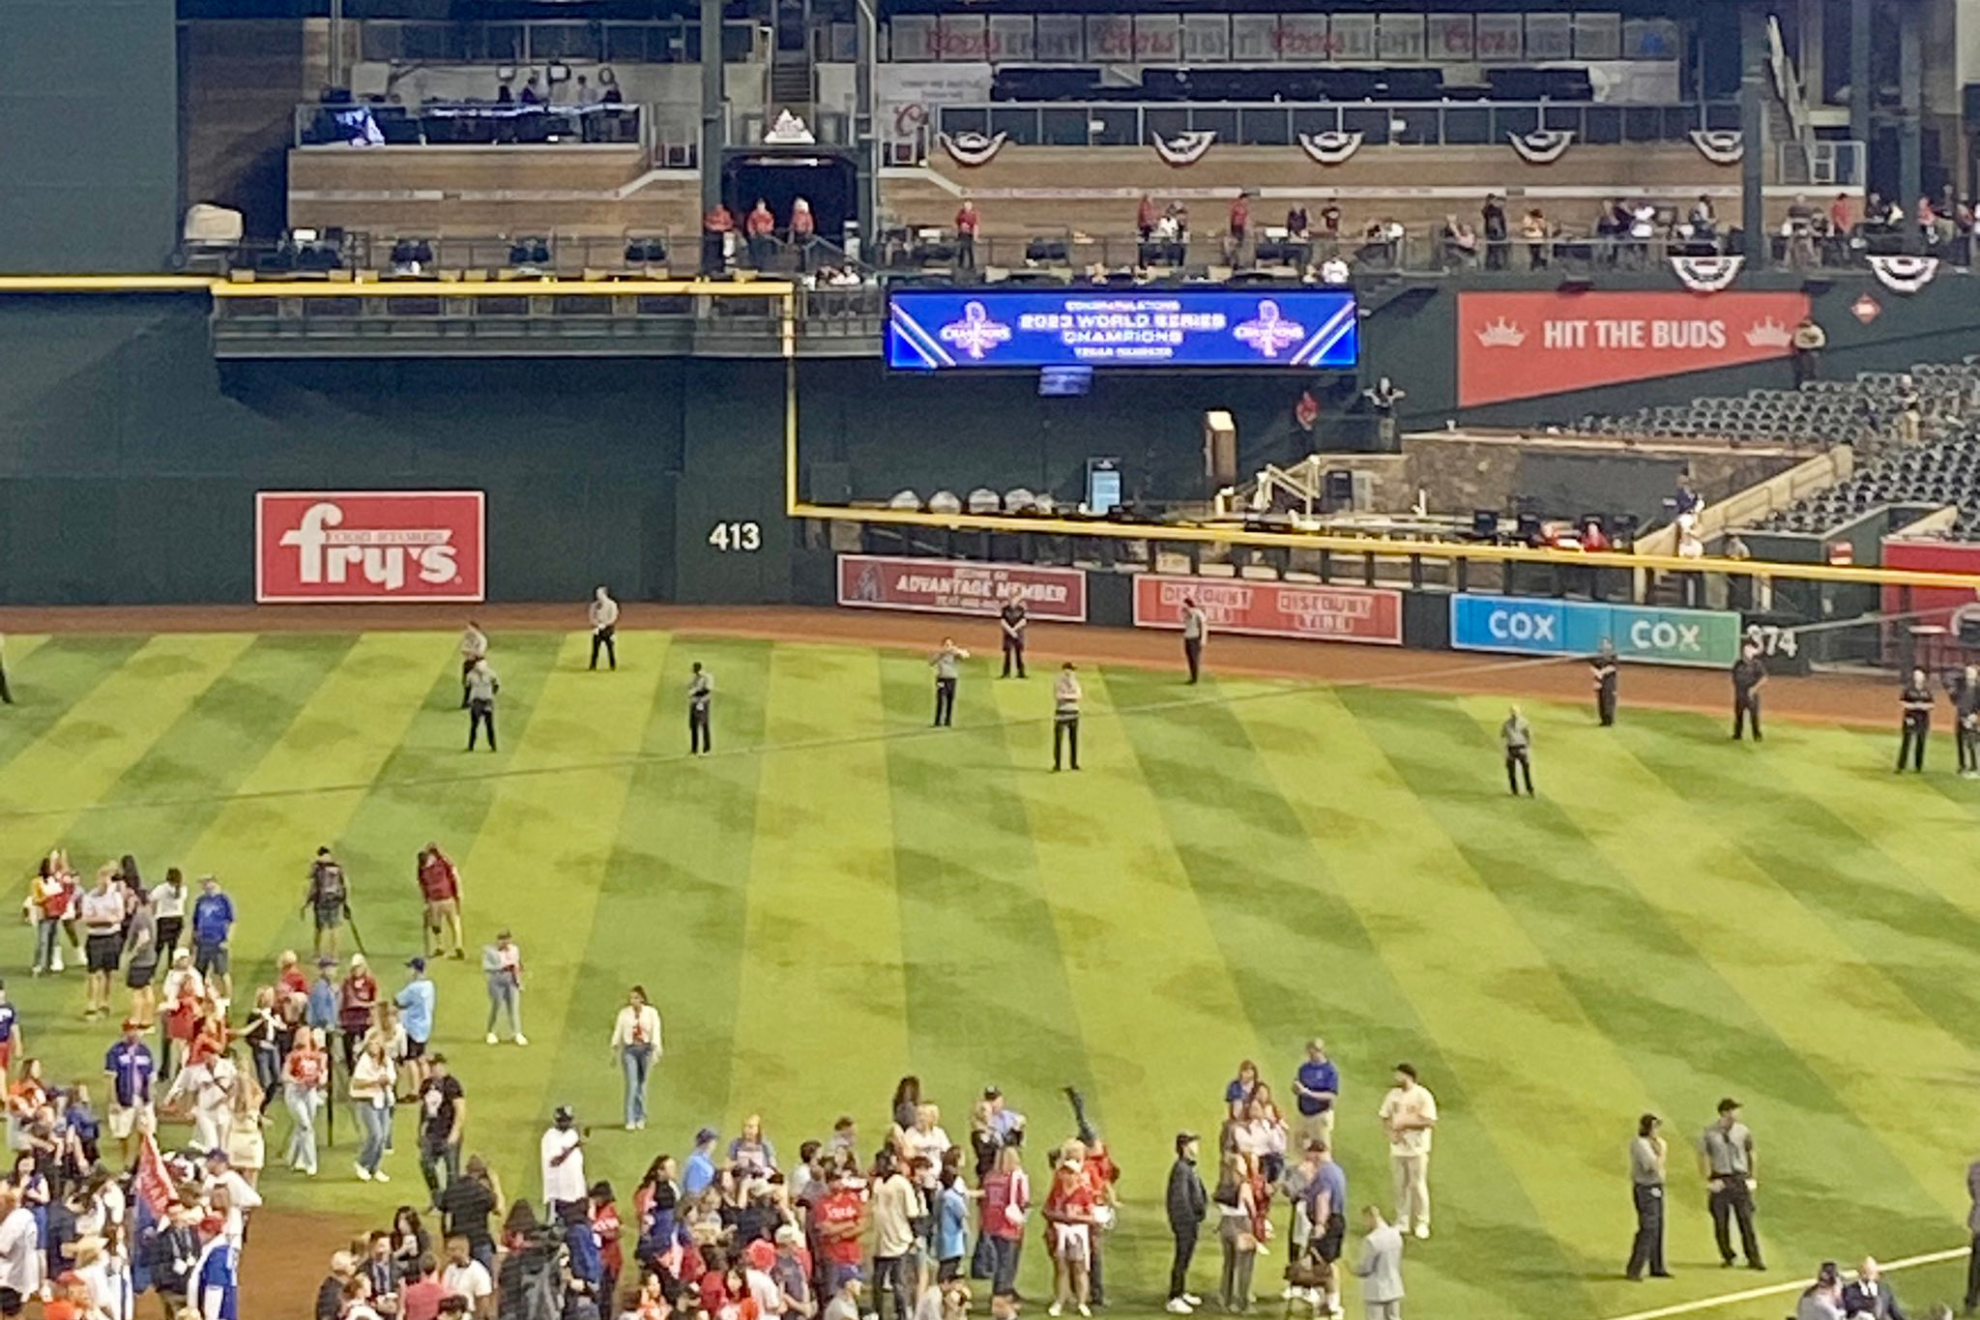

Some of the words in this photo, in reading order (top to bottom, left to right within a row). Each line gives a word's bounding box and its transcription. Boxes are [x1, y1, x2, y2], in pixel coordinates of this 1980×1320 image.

[1020, 314, 1072, 329] 2023
[1076, 314, 1149, 328] WORLD
[1154, 313, 1226, 329] SERIES
[1543, 320, 1589, 349] HIT
[1594, 320, 1646, 349] THE
[1651, 319, 1726, 349] BUDS
[1063, 330, 1183, 344] CHAMPIONS
[280, 502, 458, 590] fry's
[709, 522, 762, 551] 413
[896, 575, 994, 597] ADVANTAGE
[1488, 609, 1555, 642] COX
[1631, 619, 1700, 651] COX
